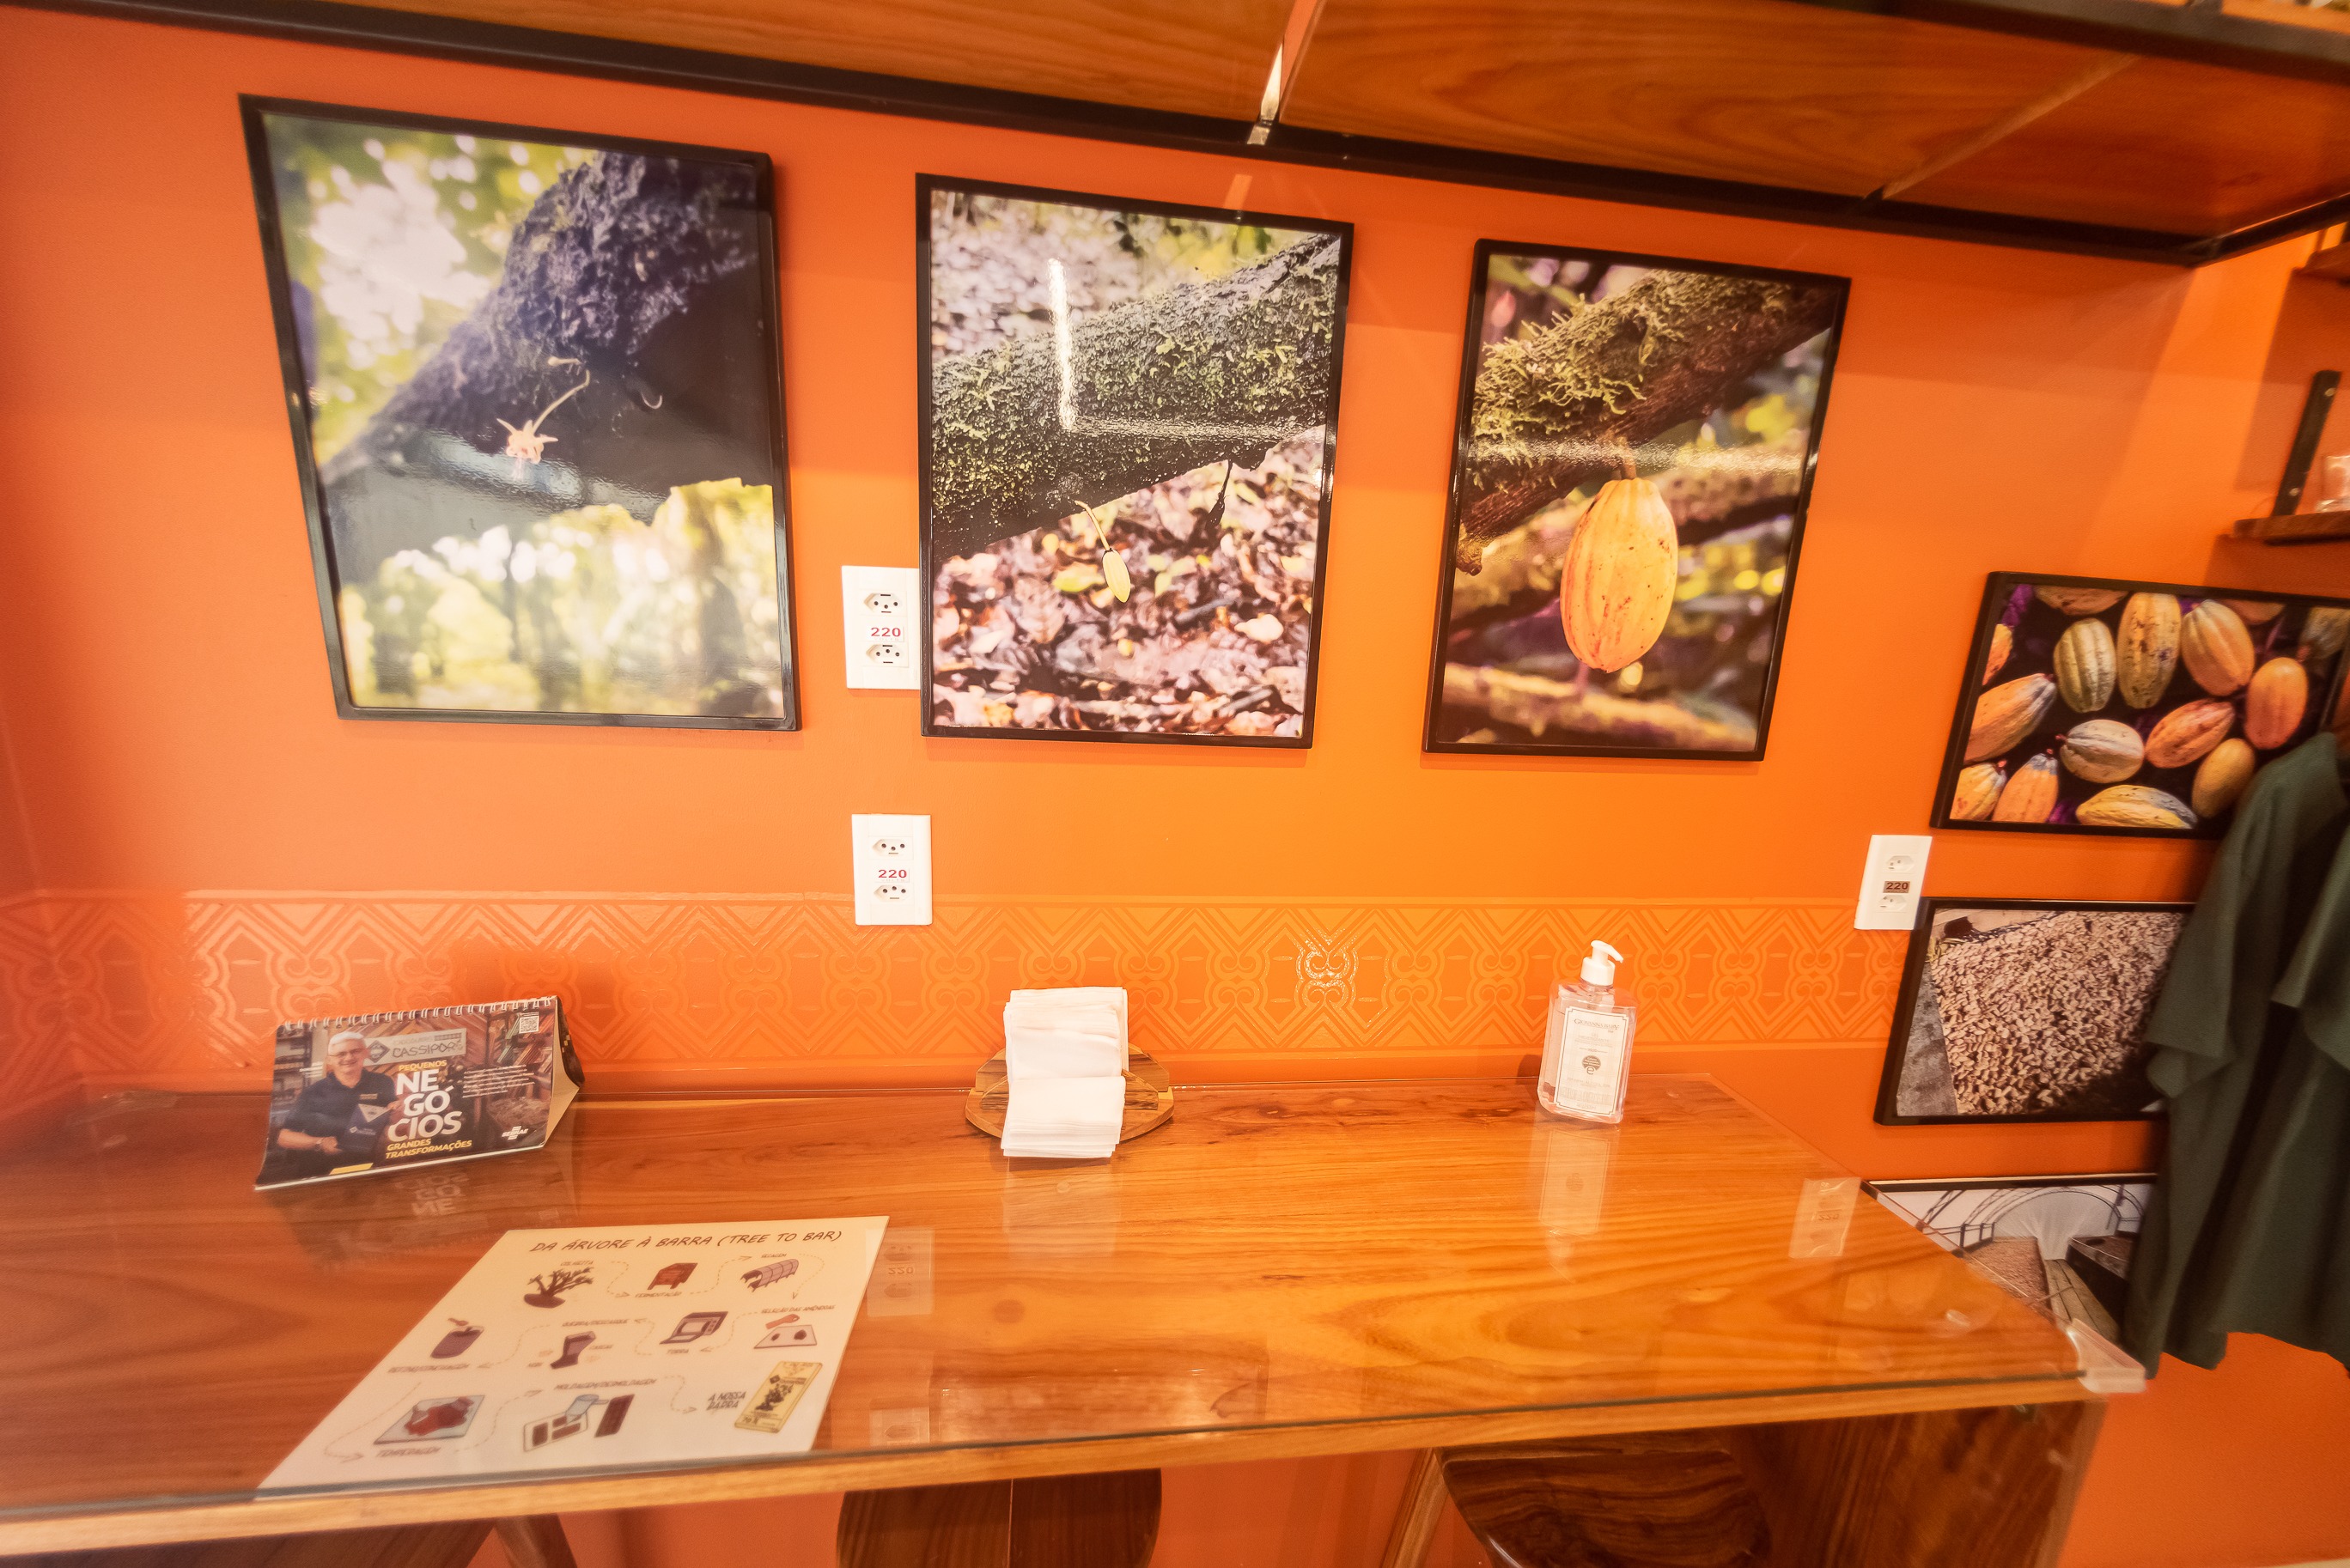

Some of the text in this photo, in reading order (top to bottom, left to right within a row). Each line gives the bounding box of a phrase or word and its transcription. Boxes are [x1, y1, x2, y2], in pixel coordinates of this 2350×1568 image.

[871, 627, 901, 637] 220
[878, 869, 907, 878] 220
[1886, 882, 1909, 890] 220
[399, 1060, 447, 1072] PEQUENOS
[396, 1068, 440, 1096] NE
[403, 1085, 454, 1116] GÓ
[387, 1111, 463, 1142] CIOS
[386, 1140, 472, 1159] TRANSFORMAÇÕES
[387, 1139, 432, 1152] GRANDES
[529, 1231, 843, 1252] DA ÁRVORE À BARRA (TREE TO BAR)
